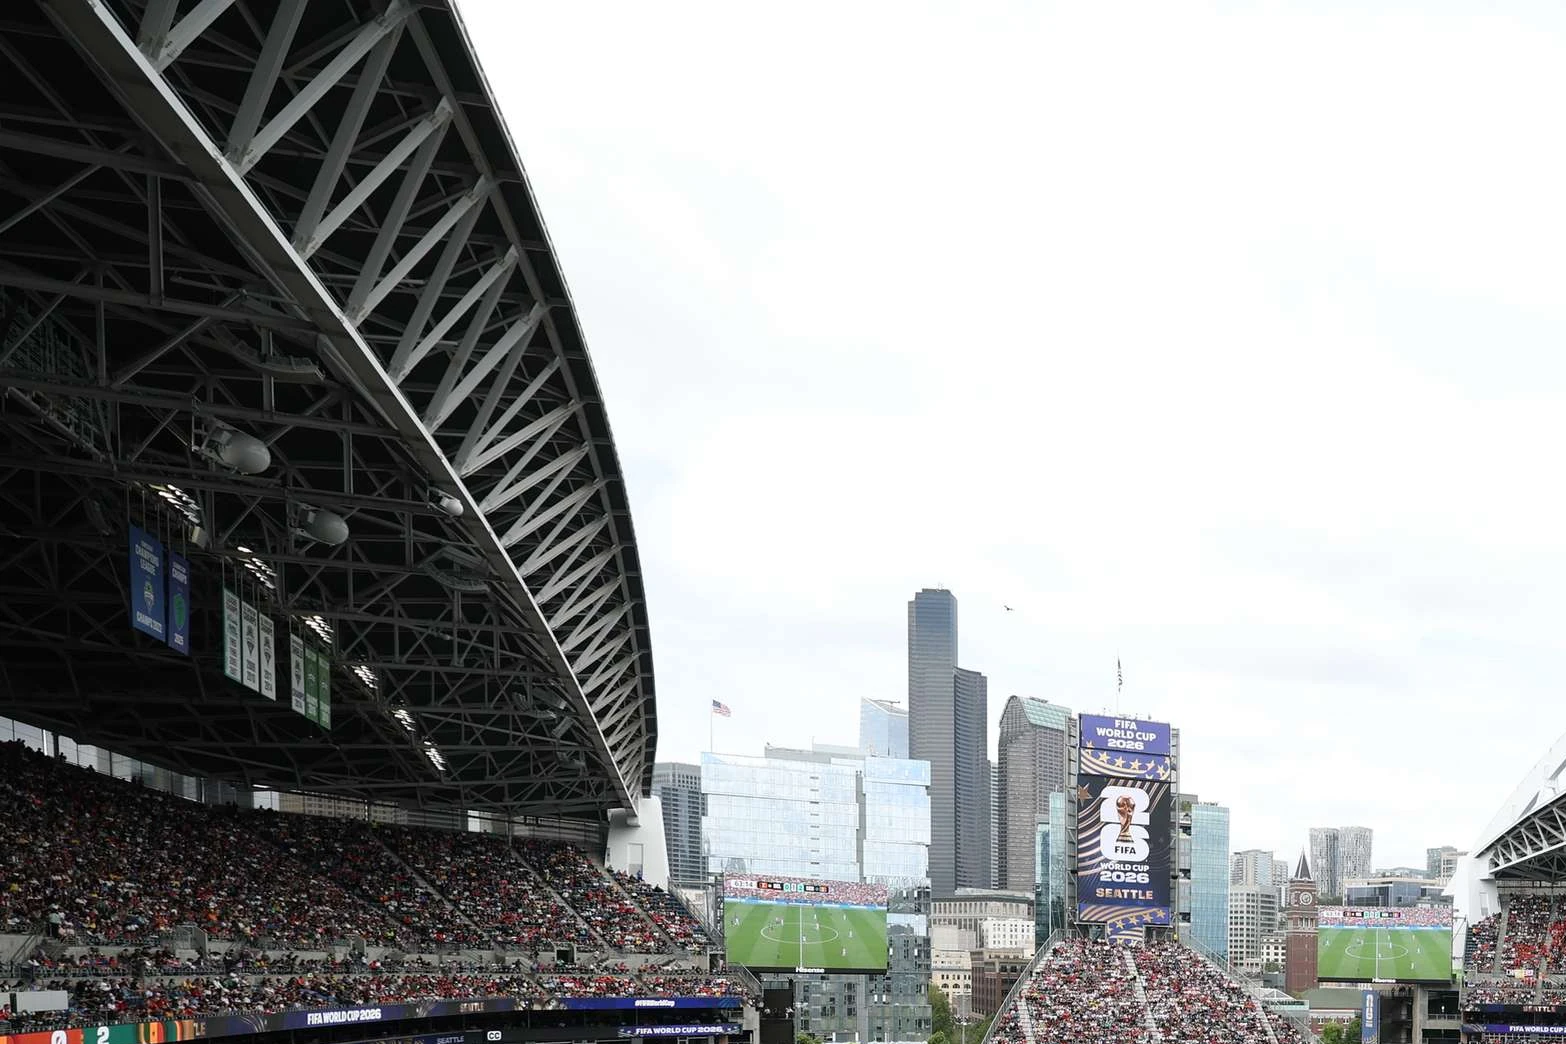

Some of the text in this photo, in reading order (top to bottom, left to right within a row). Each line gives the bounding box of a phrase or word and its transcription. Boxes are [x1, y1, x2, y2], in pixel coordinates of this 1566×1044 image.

[1115, 720, 1137, 730] FIFA
[1096, 728, 1157, 742] WORLD CUP
[1107, 739, 1144, 750] 2026
[1114, 846, 1136, 855] FIFA
[1100, 862, 1150, 872] WORLD CUP
[1100, 871, 1150, 884] 2026
[1095, 888, 1153, 900] SEATTLE
[307, 1009, 381, 1025] FIFA WORLD CUP 2026
[488, 1032, 501, 1040] CC
